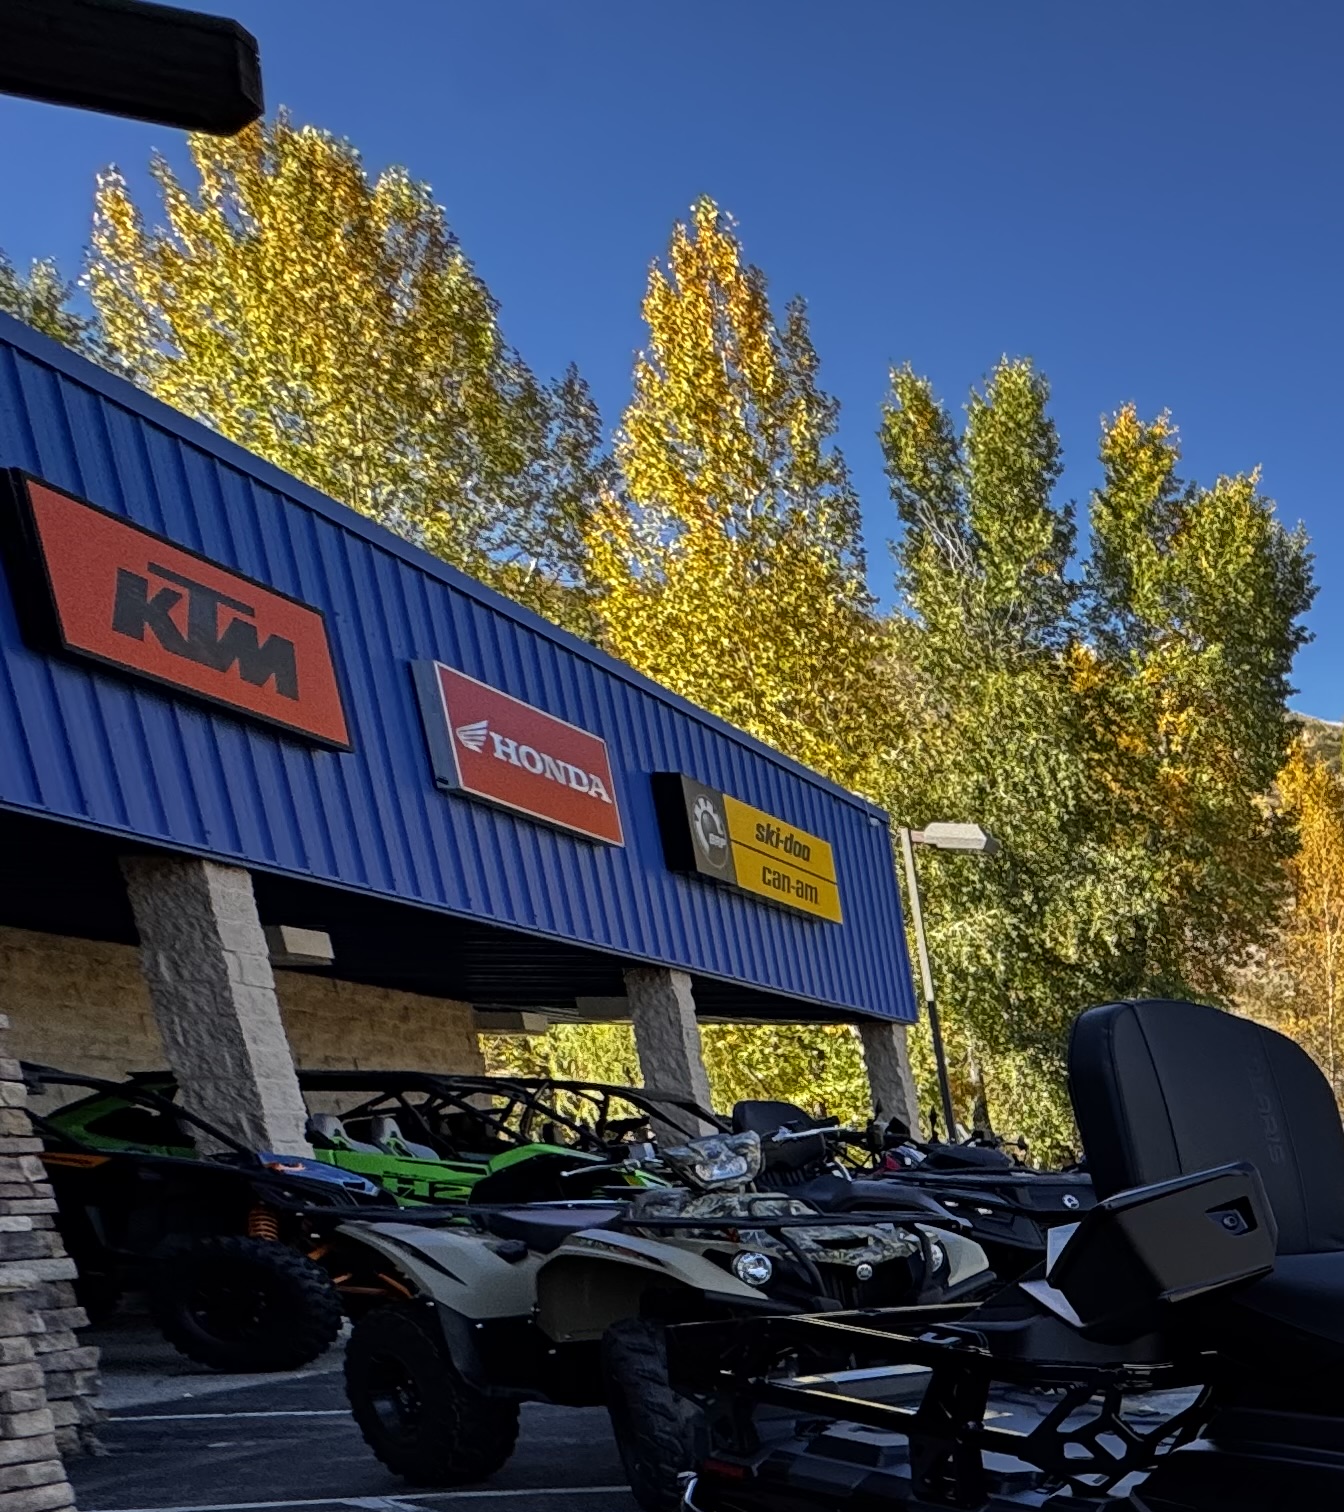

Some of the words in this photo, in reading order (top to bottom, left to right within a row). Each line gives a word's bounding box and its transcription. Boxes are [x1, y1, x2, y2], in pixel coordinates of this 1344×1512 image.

[112, 562, 299, 700] KTM
[490, 731, 612, 804] HONDA
[755, 823, 811, 862] ski-doo
[762, 865, 818, 904] can-am
